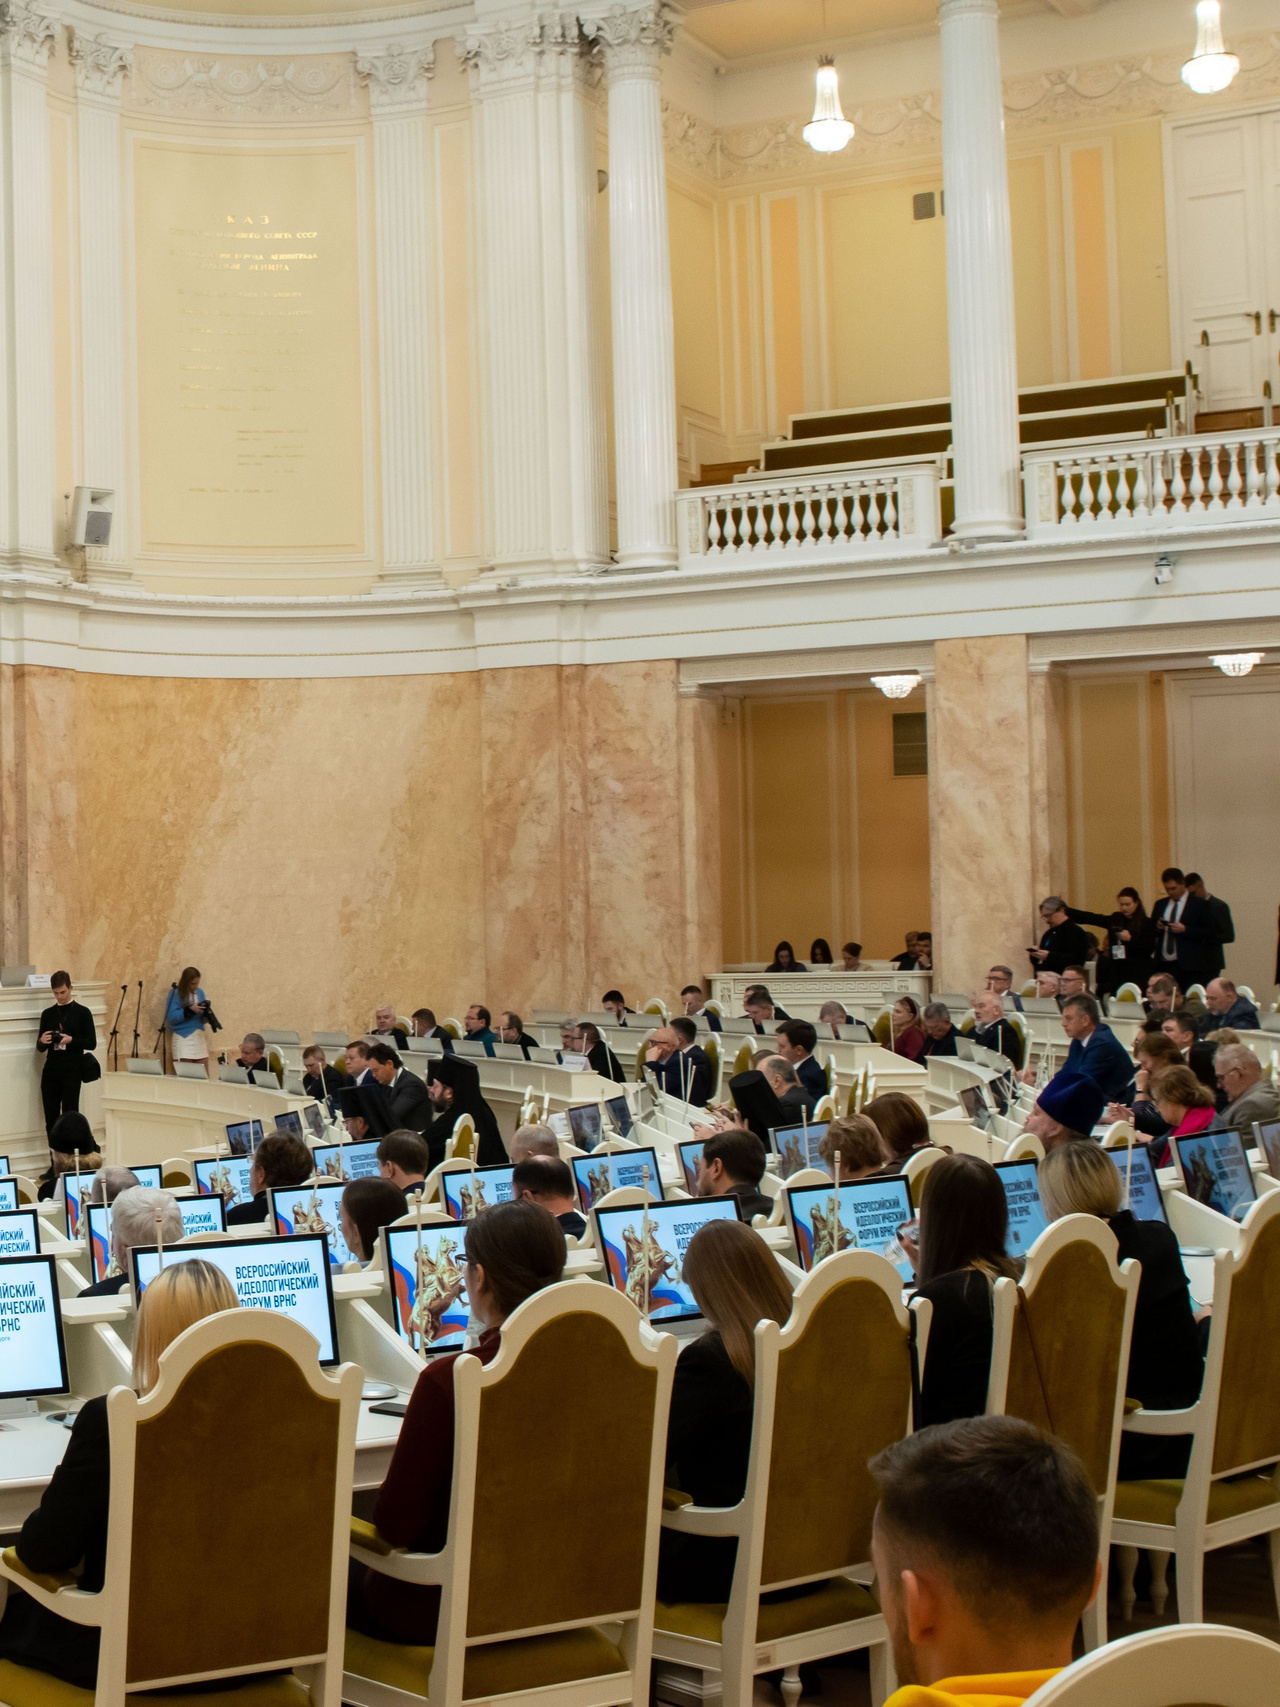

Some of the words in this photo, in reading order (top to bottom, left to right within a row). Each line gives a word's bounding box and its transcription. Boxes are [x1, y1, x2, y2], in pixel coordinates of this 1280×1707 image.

[296, 231, 318, 239] СССР
[249, 263, 290, 272] ЛЕНИНА
[235, 1258, 311, 1279] ВСЕРОССИЙСКИЙ
[237, 1273, 319, 1296] ИДЕОЛОГИЧЕСКИЙ
[273, 1293, 297, 1308] ВРНС
